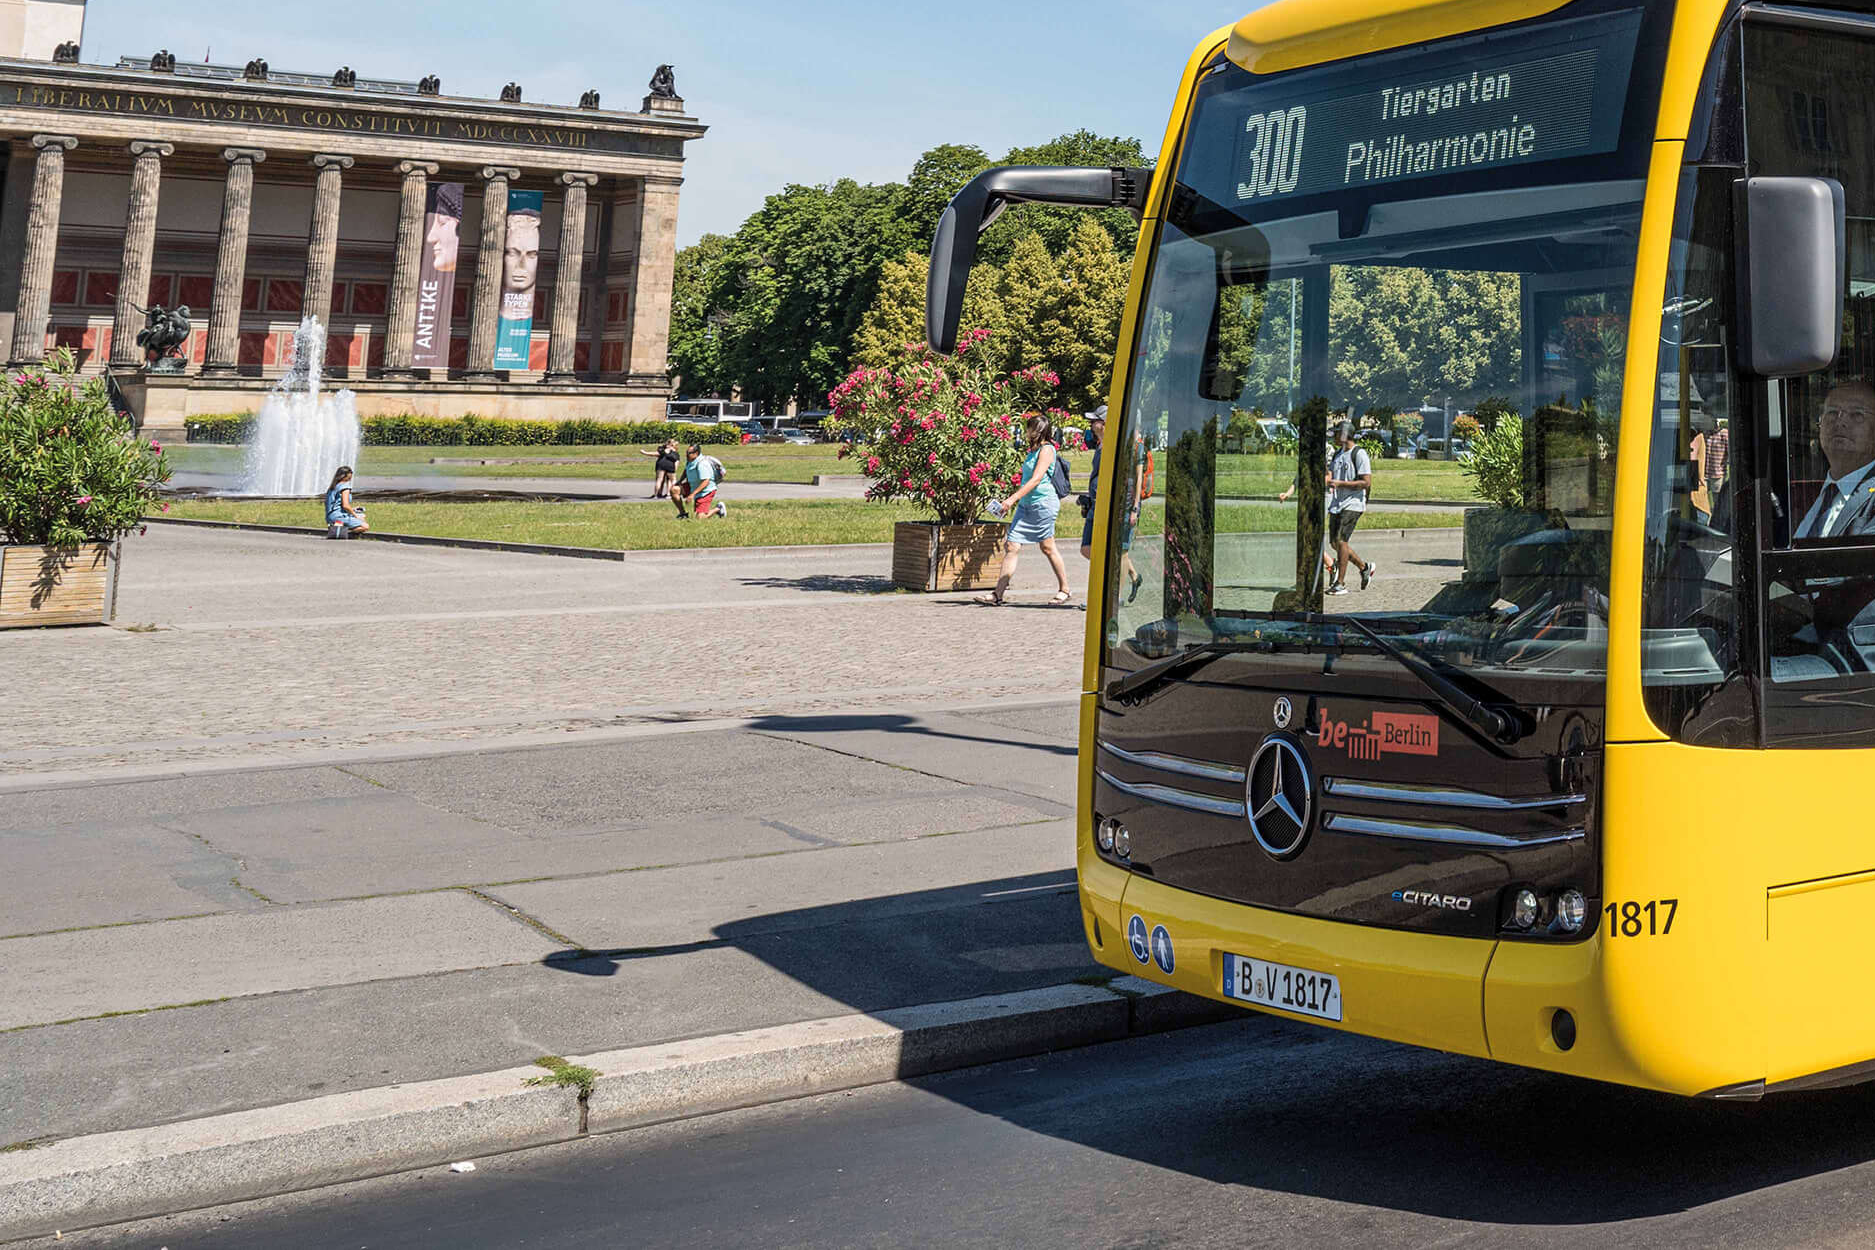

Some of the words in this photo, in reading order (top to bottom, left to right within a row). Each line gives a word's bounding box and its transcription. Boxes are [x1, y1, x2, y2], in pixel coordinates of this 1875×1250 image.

[188, 101, 289, 124] MVSEVM
[302, 110, 442, 135] CONSTITVIT
[1381, 71, 1511, 120] Tiergarten
[1237, 105, 1307, 200] 300
[1344, 114, 1536, 184] Philharmonie
[416, 280, 438, 349] ANTIKE
[1318, 707, 1348, 748] be
[1384, 722, 1432, 747] Berlin
[1392, 890, 1472, 910] eCITARO
[1604, 899, 1679, 938] 1817
[1241, 961, 1253, 996] B
[1266, 965, 1278, 1002] V
[1282, 970, 1333, 1013] 1817
